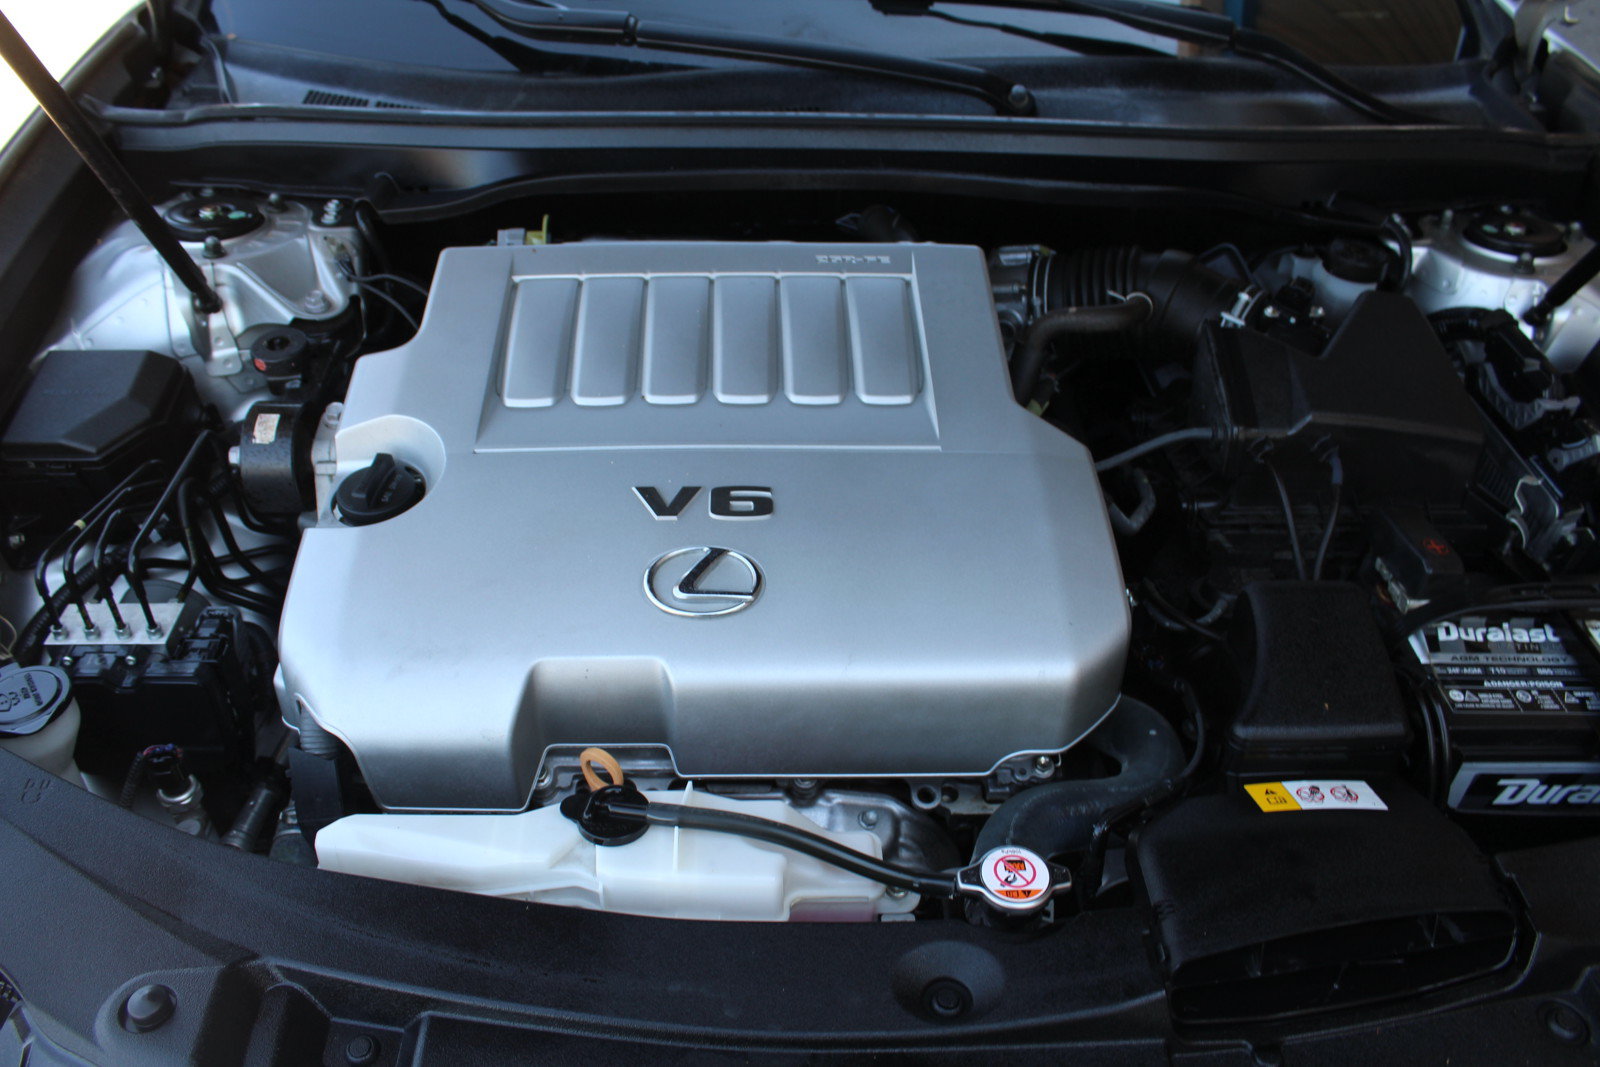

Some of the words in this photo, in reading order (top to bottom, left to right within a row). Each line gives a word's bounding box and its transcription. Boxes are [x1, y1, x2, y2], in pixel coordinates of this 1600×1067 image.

[631, 485, 774, 522] V6
[1437, 621, 1560, 643] Duralast
[1492, 779, 1600, 806] Dura
